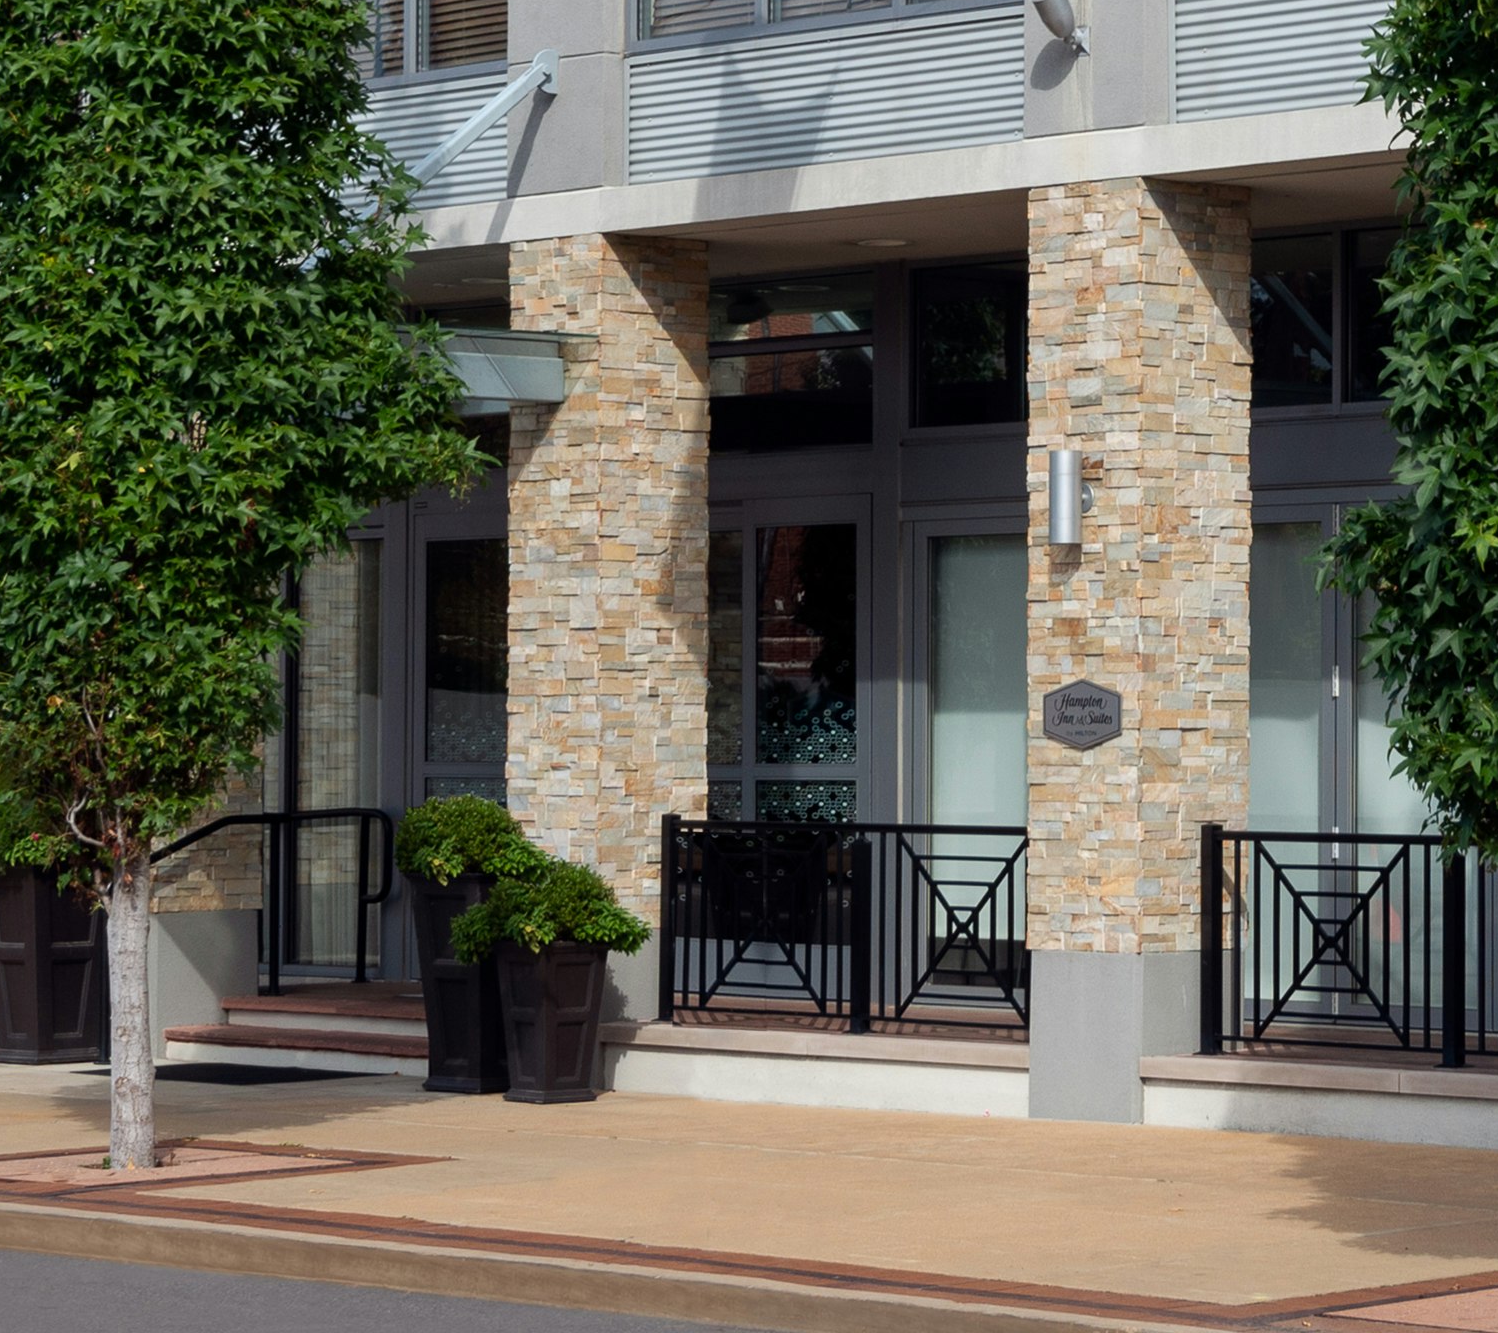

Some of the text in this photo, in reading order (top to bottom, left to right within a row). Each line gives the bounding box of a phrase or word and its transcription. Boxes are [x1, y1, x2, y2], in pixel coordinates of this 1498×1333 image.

[1054, 693, 1107, 711] Hampton
[1052, 711, 1077, 727] Inn
[1085, 710, 1112, 725] Suites
